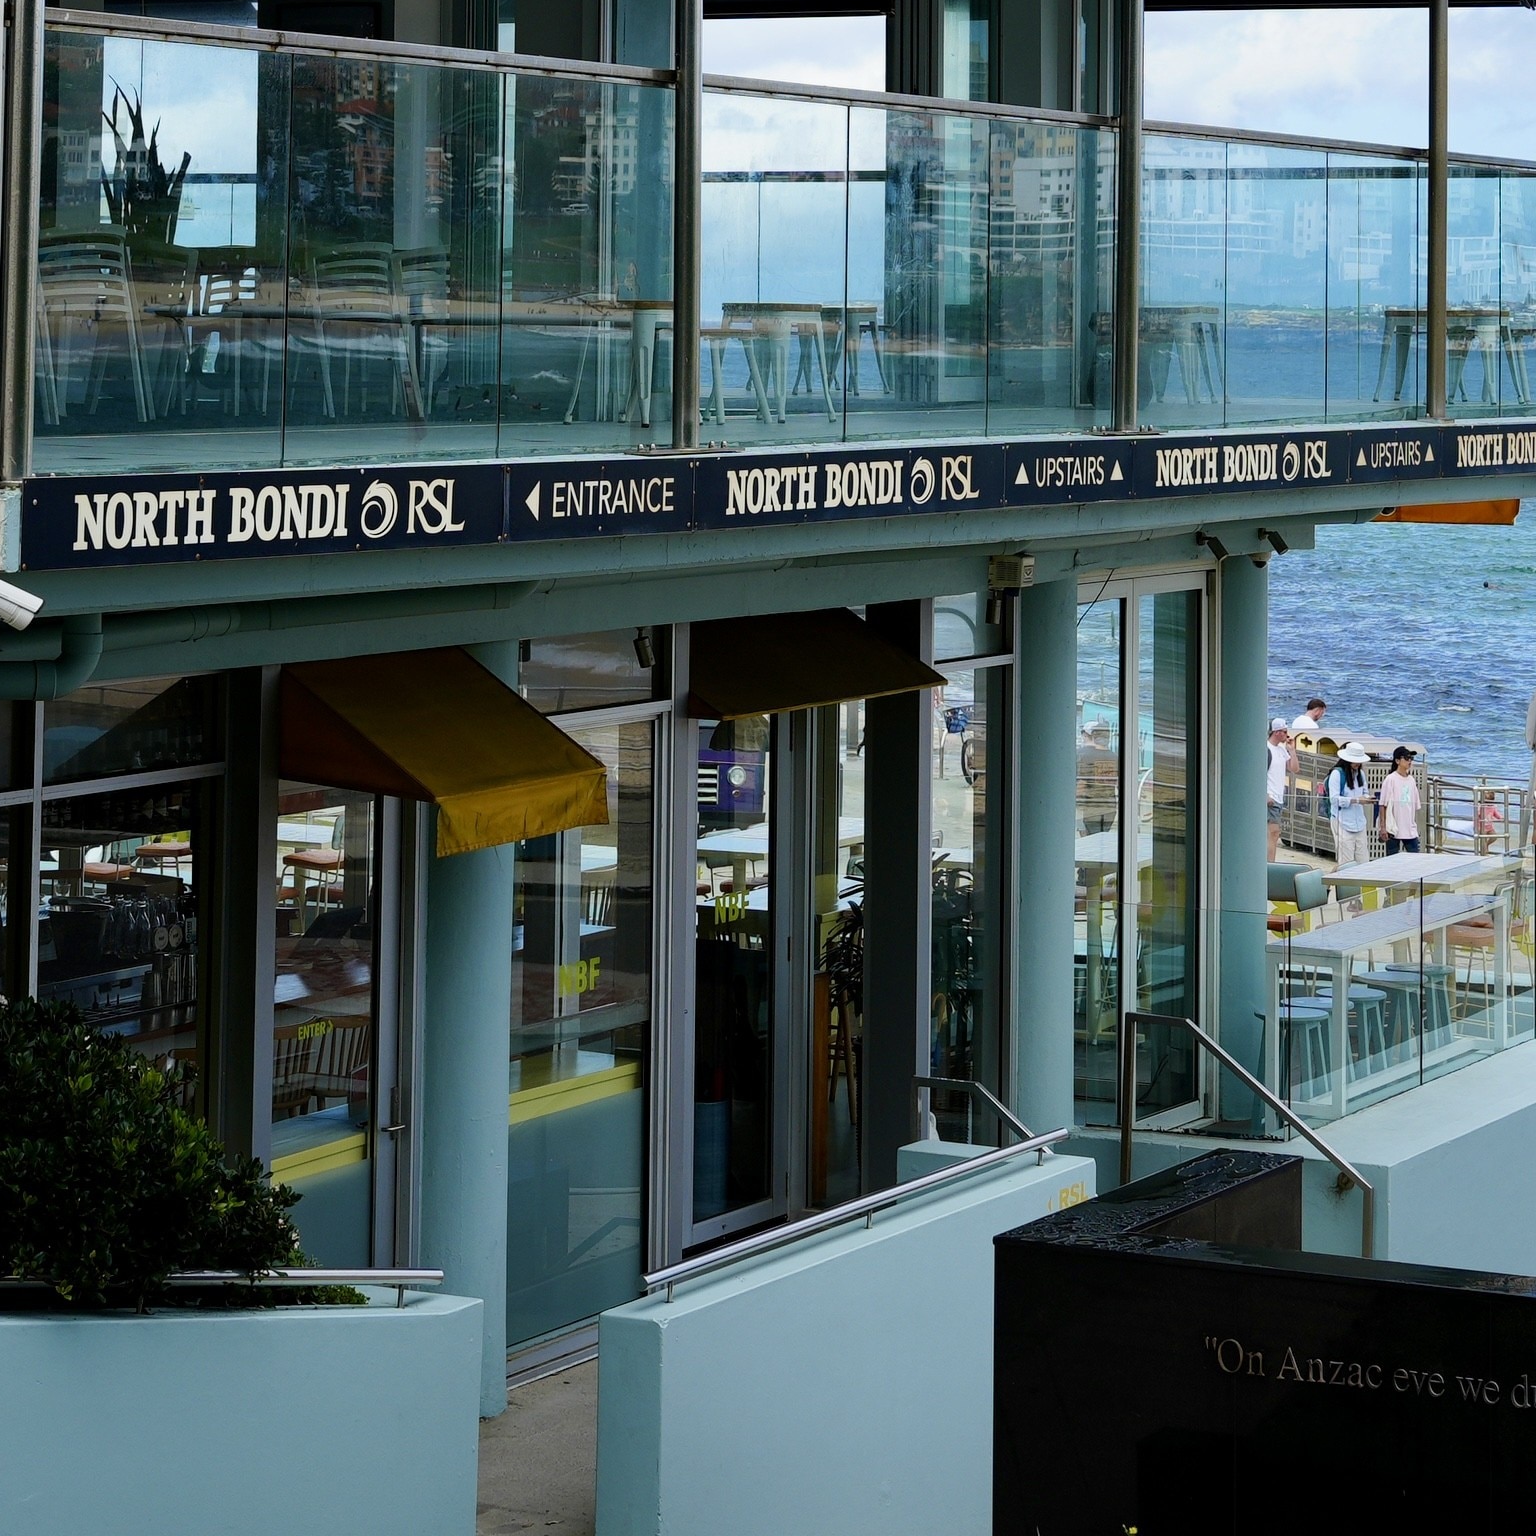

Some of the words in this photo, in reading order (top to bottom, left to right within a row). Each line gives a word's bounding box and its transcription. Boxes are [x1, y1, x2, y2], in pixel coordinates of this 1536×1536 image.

[1155, 447, 1218, 487] NORTH
[1223, 443, 1278, 482] BONDI
[1303, 440, 1332, 479] RSL
[1370, 440, 1421, 469] UPSTAIRS
[1456, 433, 1503, 467] NORTH
[725, 465, 818, 515] NORTH
[823, 460, 904, 508] BONDI
[940, 455, 980, 501] RSL
[1035, 455, 1105, 488] UPSTAIRS
[72, 489, 217, 551] NORTH
[227, 483, 351, 543] BONDI
[405, 478, 466, 535] RSL
[552, 476, 675, 518] ENTRANCE
[714, 888, 751, 926] NBF
[558, 956, 601, 997] NBF
[297, 1021, 326, 1041] ENTER
[1059, 1181, 1089, 1210] RSL
[1276, 1345, 1383, 1389] Anzac
[1393, 1367, 1446, 1398] eve
[1455, 1375, 1500, 1404] we
